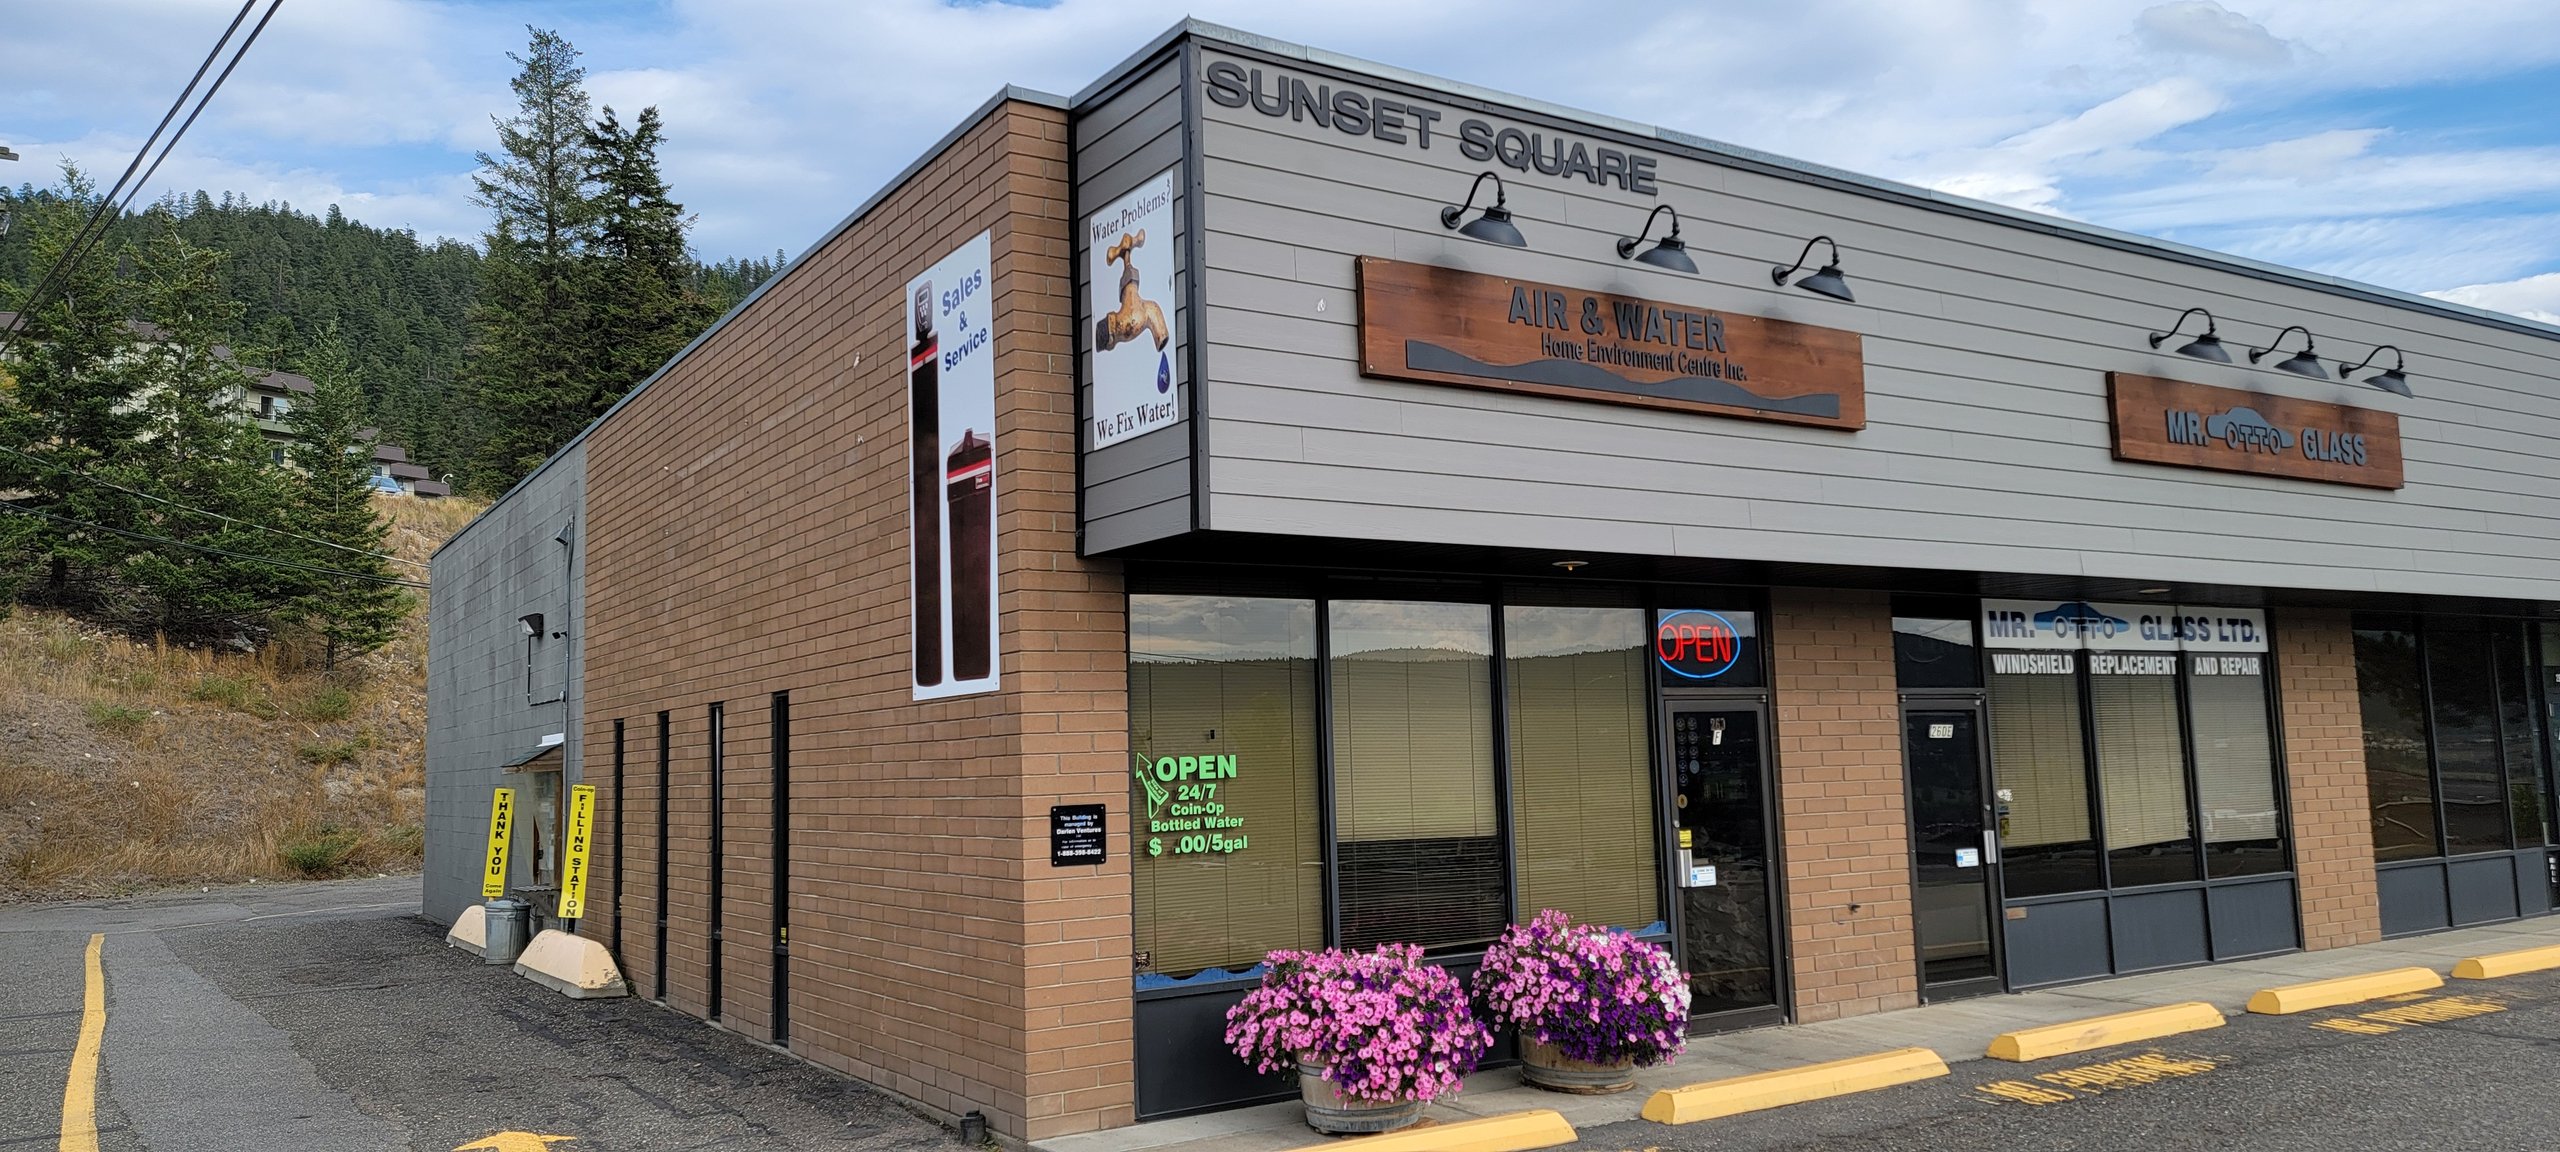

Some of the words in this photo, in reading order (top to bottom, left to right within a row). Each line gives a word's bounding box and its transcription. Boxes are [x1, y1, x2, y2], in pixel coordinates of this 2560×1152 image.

[1207, 61, 1441, 149] SUNSET
[1460, 119, 1658, 195] SQUARE
[1092, 219, 1120, 244] Water
[1121, 179, 1171, 229] Problems?
[942, 268, 982, 317] Sales
[959, 310, 968, 332] &
[1508, 286, 1569, 331] AIR
[1580, 297, 1605, 336] &
[1613, 301, 1728, 353] WATER
[944, 327, 988, 372] Service
[1541, 332, 1584, 361] Home
[1587, 338, 1674, 373] Environment
[1678, 351, 1722, 377] Centre
[1724, 360, 1748, 381] Inc.
[1096, 418, 1114, 442] We
[1116, 411, 1134, 435] Fix
[1136, 393, 1176, 428] Water!
[2165, 408, 2209, 447] MR.
[2225, 421, 2282, 455] OTTO
[2302, 427, 2367, 466] GLASS
[1657, 623, 1731, 663] OPEN
[1988, 610, 2036, 638] MR.
[2053, 614, 2117, 640] OTTO
[2139, 614, 2212, 643] GLASS
[2217, 616, 2260, 644] LTD.
[1992, 653, 2074, 675] WINDSHIELD
[2090, 654, 2177, 676] REPLACEMENT
[2195, 656, 2219, 676] AND
[2221, 656, 2260, 676] REPAIR
[1156, 754, 1237, 782] OPEN
[1171, 801, 1224, 817] Coin-Op
[1178, 783, 1217, 802] 24/7
[495, 792, 509, 840] THANK
[573, 794, 587, 853] FILLING
[1151, 818, 1201, 833] Bottled
[1204, 816, 1244, 830] Water
[491, 846, 503, 875] YOU
[1149, 836, 1162, 858] $
[1175, 833, 1248, 854] .00/5gal
[566, 858, 582, 917] STATION
